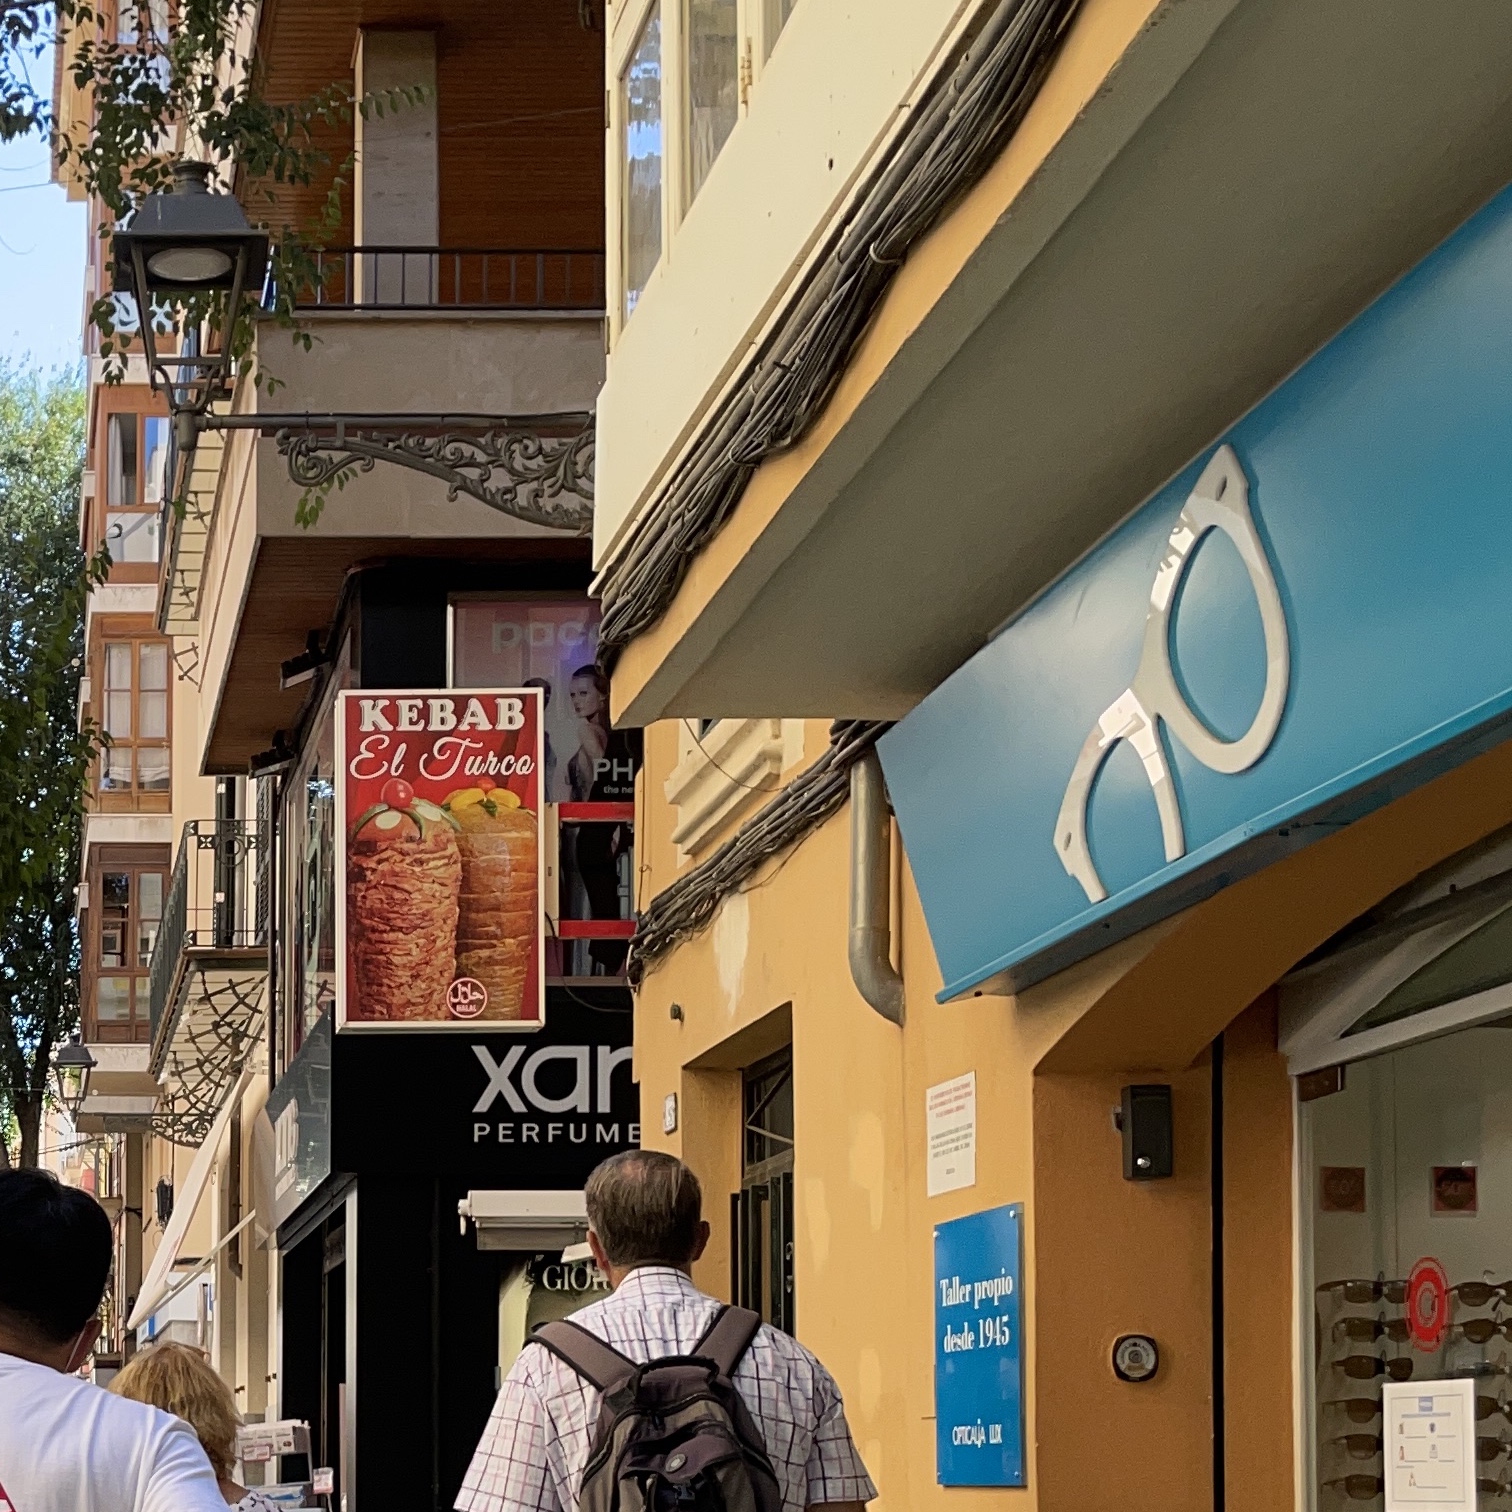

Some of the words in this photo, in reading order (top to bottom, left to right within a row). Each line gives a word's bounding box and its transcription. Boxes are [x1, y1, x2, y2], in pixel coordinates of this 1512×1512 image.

[358, 698, 525, 731] KEBAB
[350, 734, 407, 779] El
[419, 736, 535, 780] Turco
[940, 1276, 972, 1307] Taller
[974, 1267, 1014, 1310] propio
[943, 1322, 975, 1353] desde
[978, 1315, 1010, 1348] 1945
